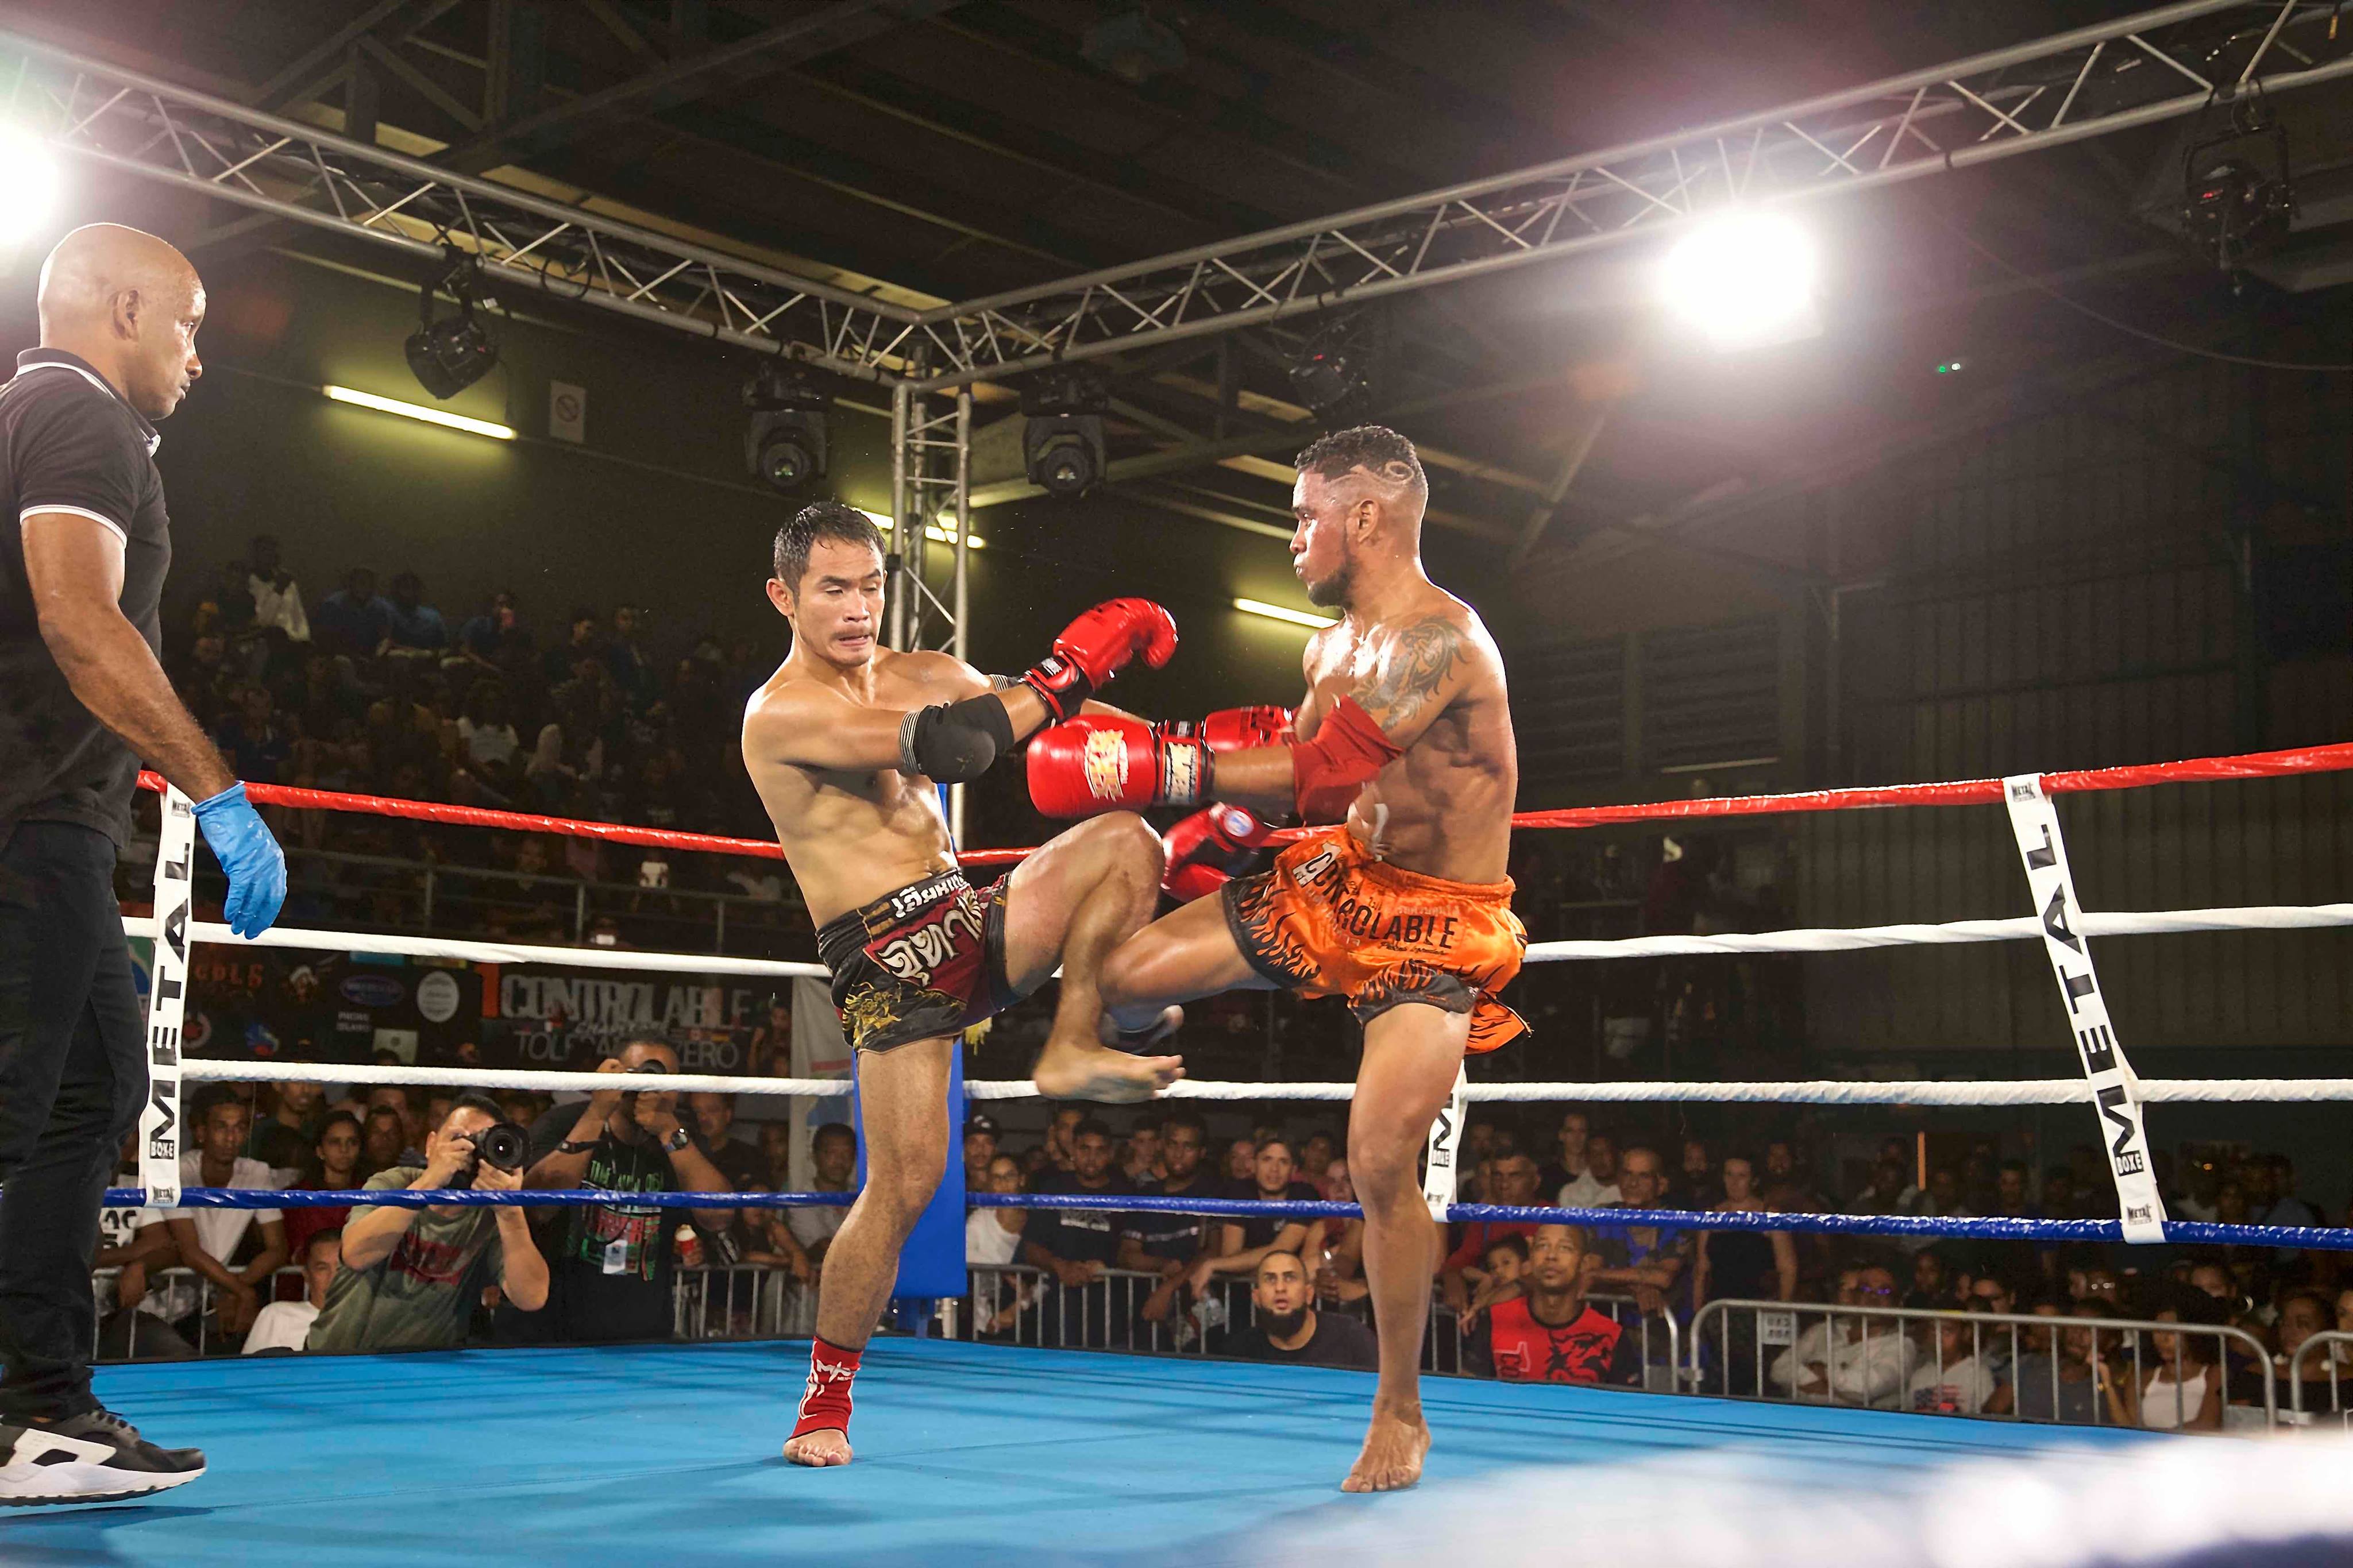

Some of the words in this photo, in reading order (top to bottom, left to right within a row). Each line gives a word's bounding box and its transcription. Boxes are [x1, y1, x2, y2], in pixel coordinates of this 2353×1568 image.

[150, 843, 190, 1140] METAL
[2027, 824, 2135, 1154] METAL
[150, 1140, 174, 1158] BOXE
[2115, 1152, 2143, 1175] BOXE
